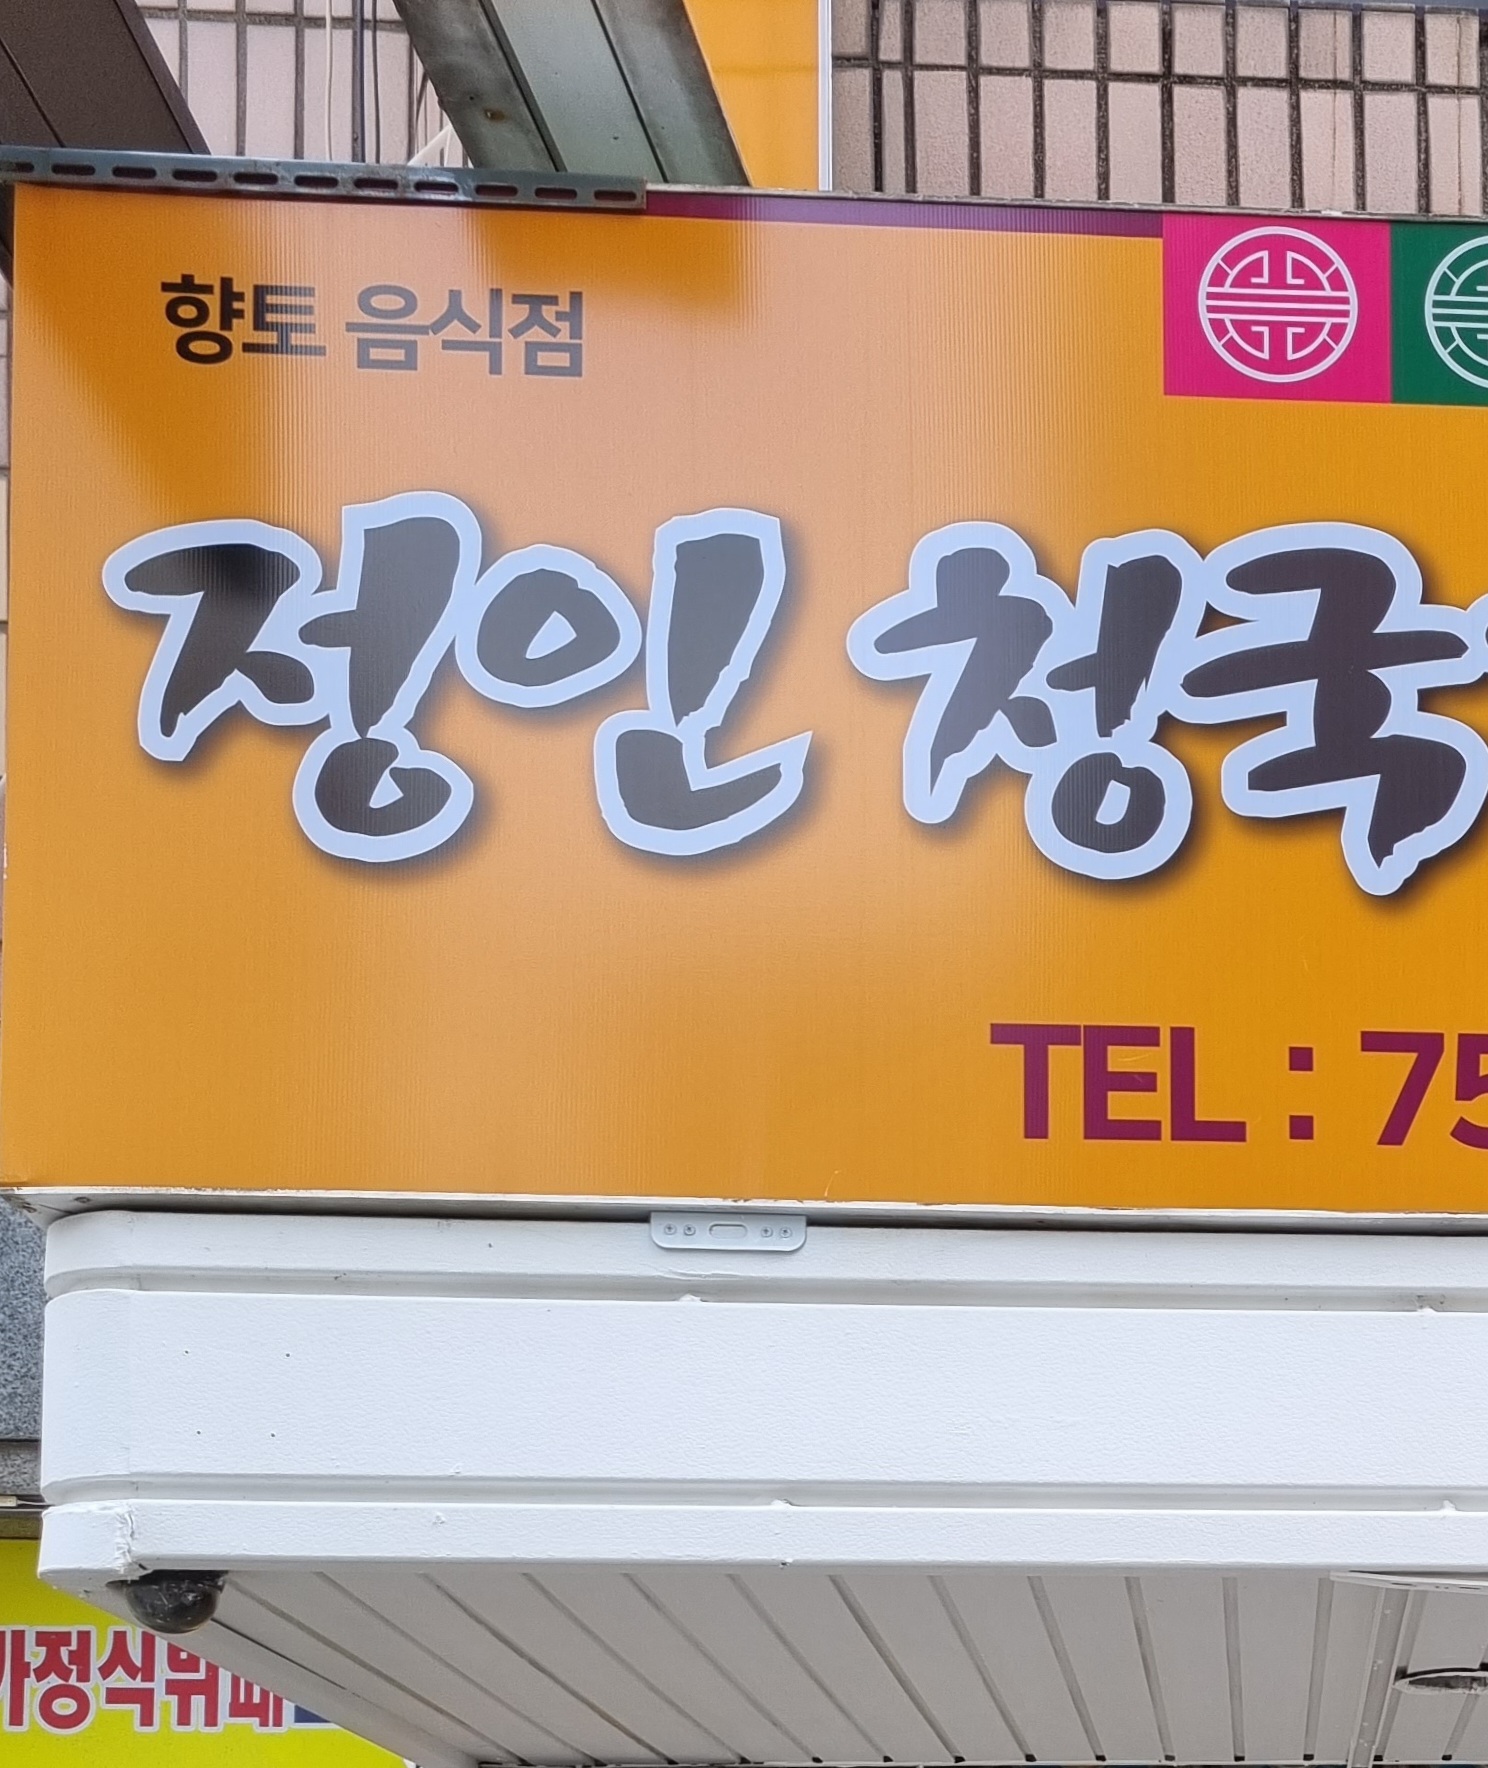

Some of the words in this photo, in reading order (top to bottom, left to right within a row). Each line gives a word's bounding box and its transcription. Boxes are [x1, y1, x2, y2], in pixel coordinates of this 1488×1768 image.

[159, 272, 327, 365] 향토
[344, 283, 586, 379] 음식점
[103, 491, 813, 863] 정인
[989, 1021, 1247, 1143] TEL
